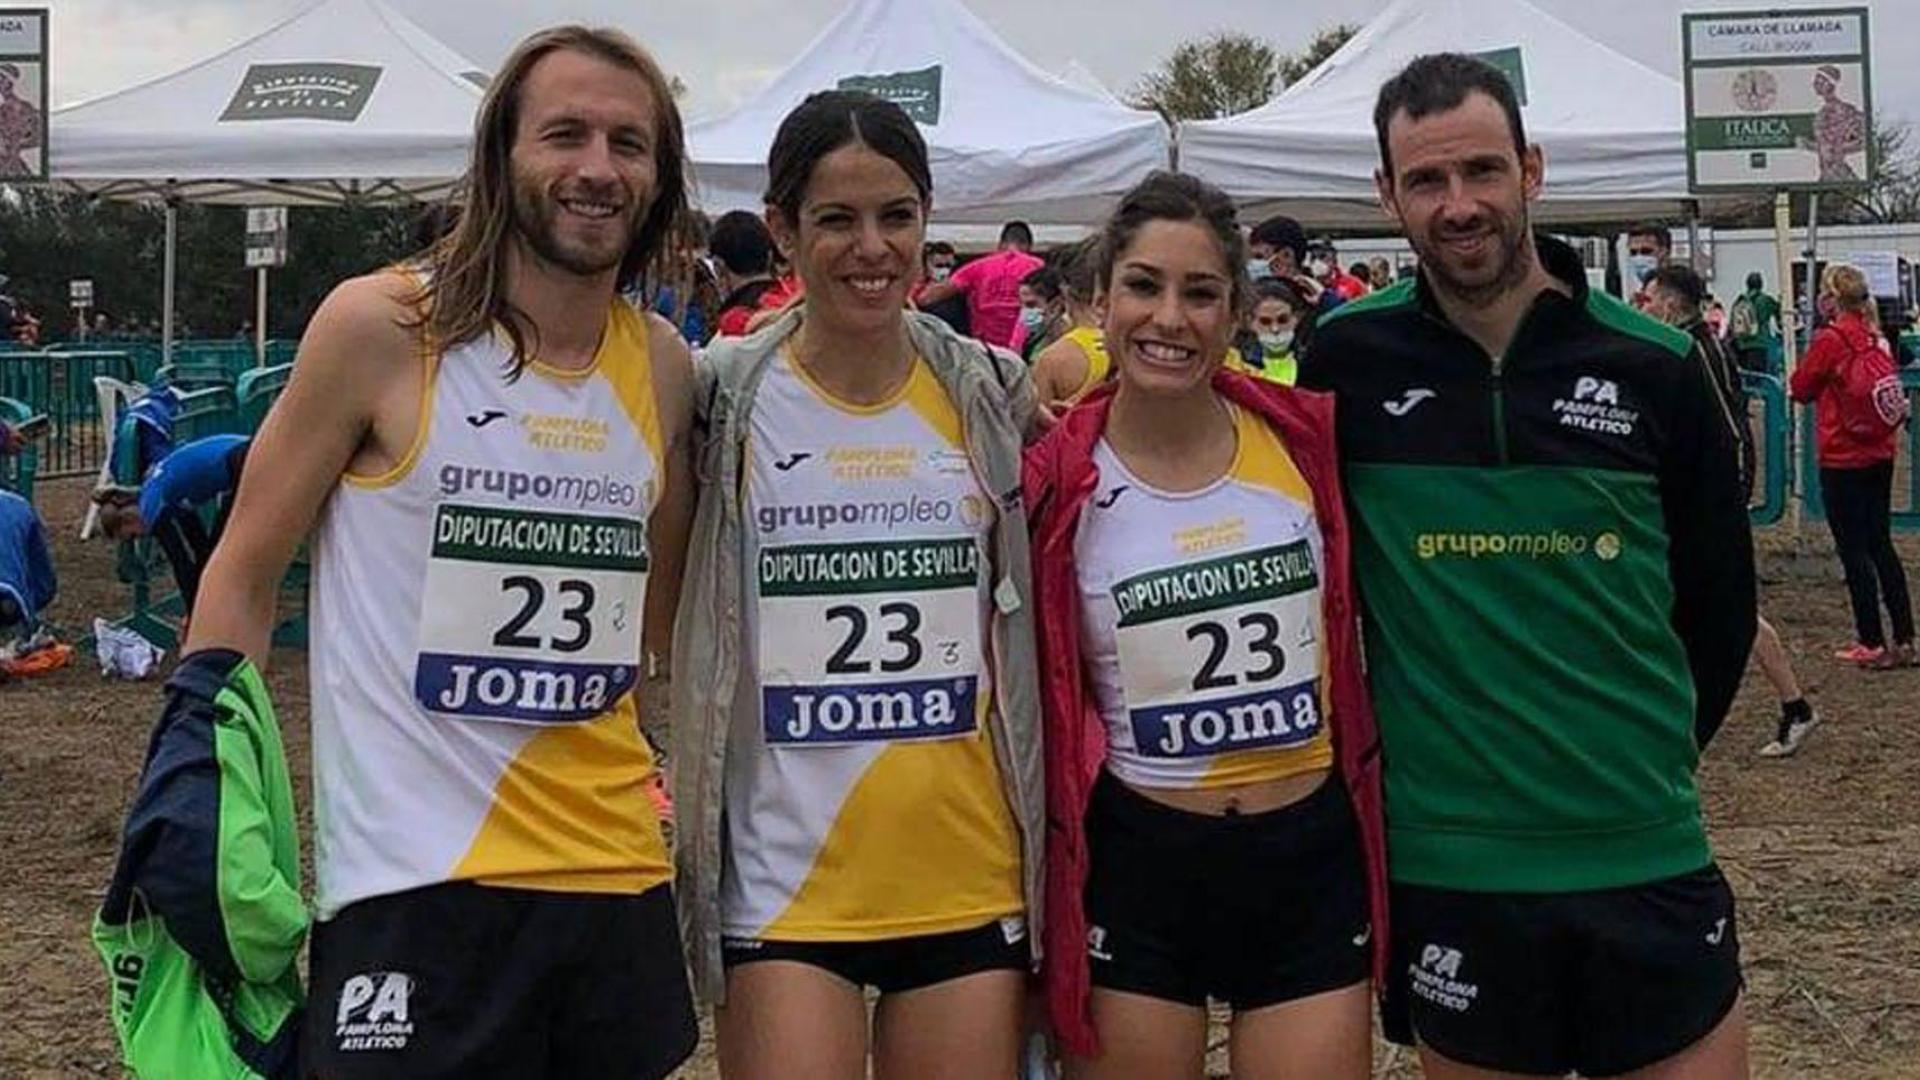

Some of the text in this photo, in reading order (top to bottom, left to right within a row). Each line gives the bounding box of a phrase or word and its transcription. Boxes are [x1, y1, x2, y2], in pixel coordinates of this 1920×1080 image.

[1763, 22, 1780, 35] DE
[1783, 21, 1842, 35] LLAMADA
[1573, 376, 1618, 405] PA
[1552, 399, 1639, 423] PAMPLONA
[440, 463, 635, 508] grupompleo
[438, 513, 566, 553] DIPUTACION
[568, 524, 590, 554] DE
[758, 494, 952, 533] grupompleo
[1417, 529, 1588, 559] grupompleo
[762, 550, 878, 583] DIPUTACION
[883, 551, 907, 579] DE
[1117, 564, 1232, 615] DIPUTACION
[1234, 560, 1258, 591] DE
[493, 575, 595, 653] 23
[826, 601, 923, 674] 23
[1186, 612, 1286, 691] 23
[1421, 943, 1463, 979] PA
[336, 971, 408, 1025] PA
